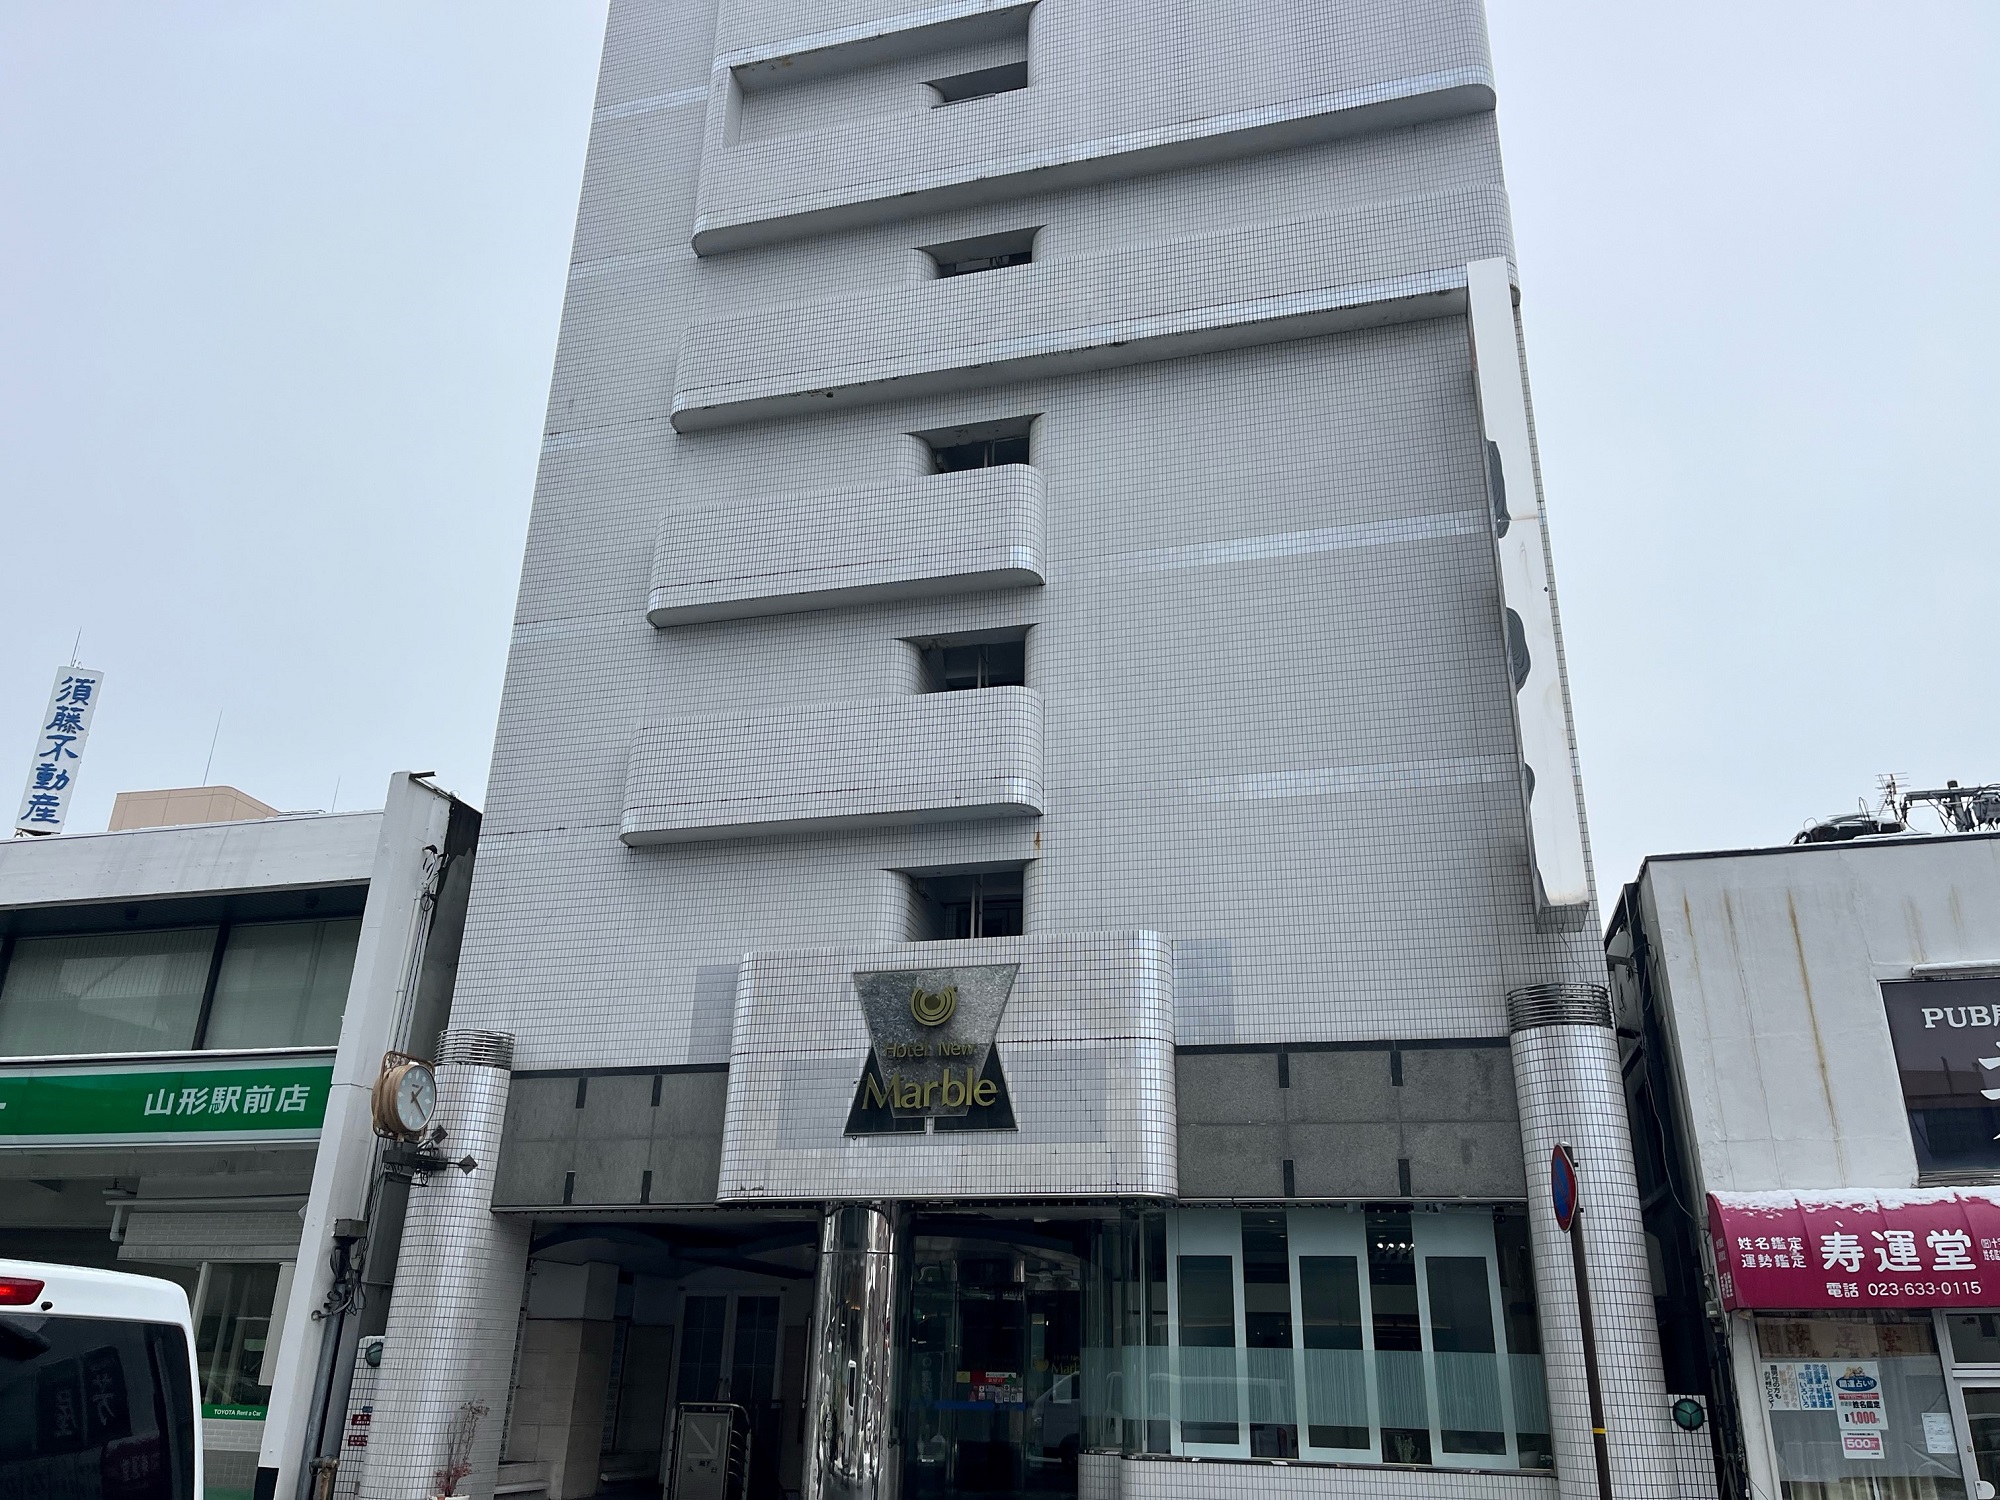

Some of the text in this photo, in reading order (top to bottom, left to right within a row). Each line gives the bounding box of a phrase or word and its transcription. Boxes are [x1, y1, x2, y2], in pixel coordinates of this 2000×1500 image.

[21, 675, 96, 823] 須藤不動産
[885, 1041, 974, 1057] Hotel New
[862, 1067, 998, 1110] Marble
[144, 1083, 310, 1116] 山形駅前店
[1737, 1236, 1804, 1251] 姓名鑑定
[1820, 1229, 1977, 1272] 寿運堂
[1741, 1253, 1807, 1269] 運勢鑑定
[1826, 1281, 1982, 1298] 電話 023-633-0115
[214, 1408, 236, 1416] TOYOTA
